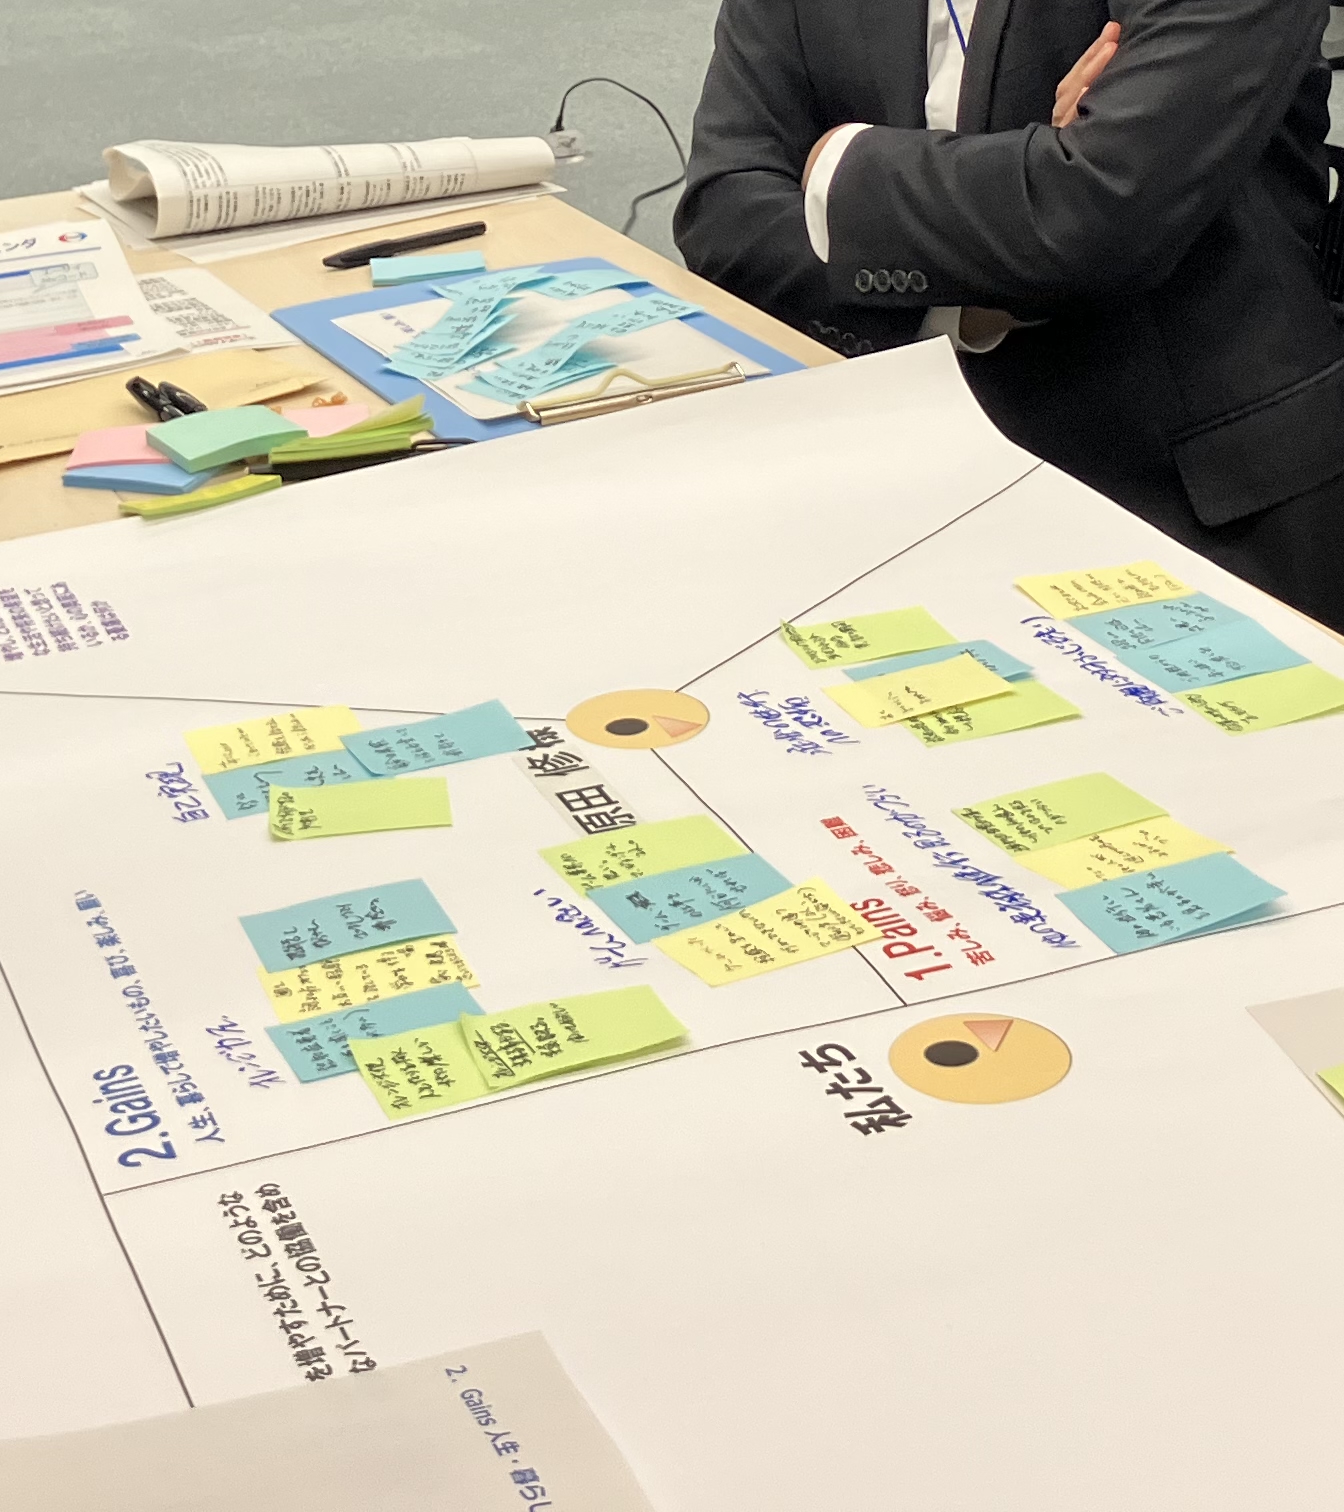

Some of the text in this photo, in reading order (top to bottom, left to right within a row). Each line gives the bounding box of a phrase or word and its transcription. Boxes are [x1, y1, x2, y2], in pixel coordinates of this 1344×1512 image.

[553, 781, 640, 837] 原田
[849, 894, 952, 985] 1.Pains
[93, 1062, 180, 1170] 2.Gains
[799, 1040, 914, 1137] 私たち
[218, 1190, 334, 1383] を増やすために、どのような
[458, 1387, 499, 1429] Gains
